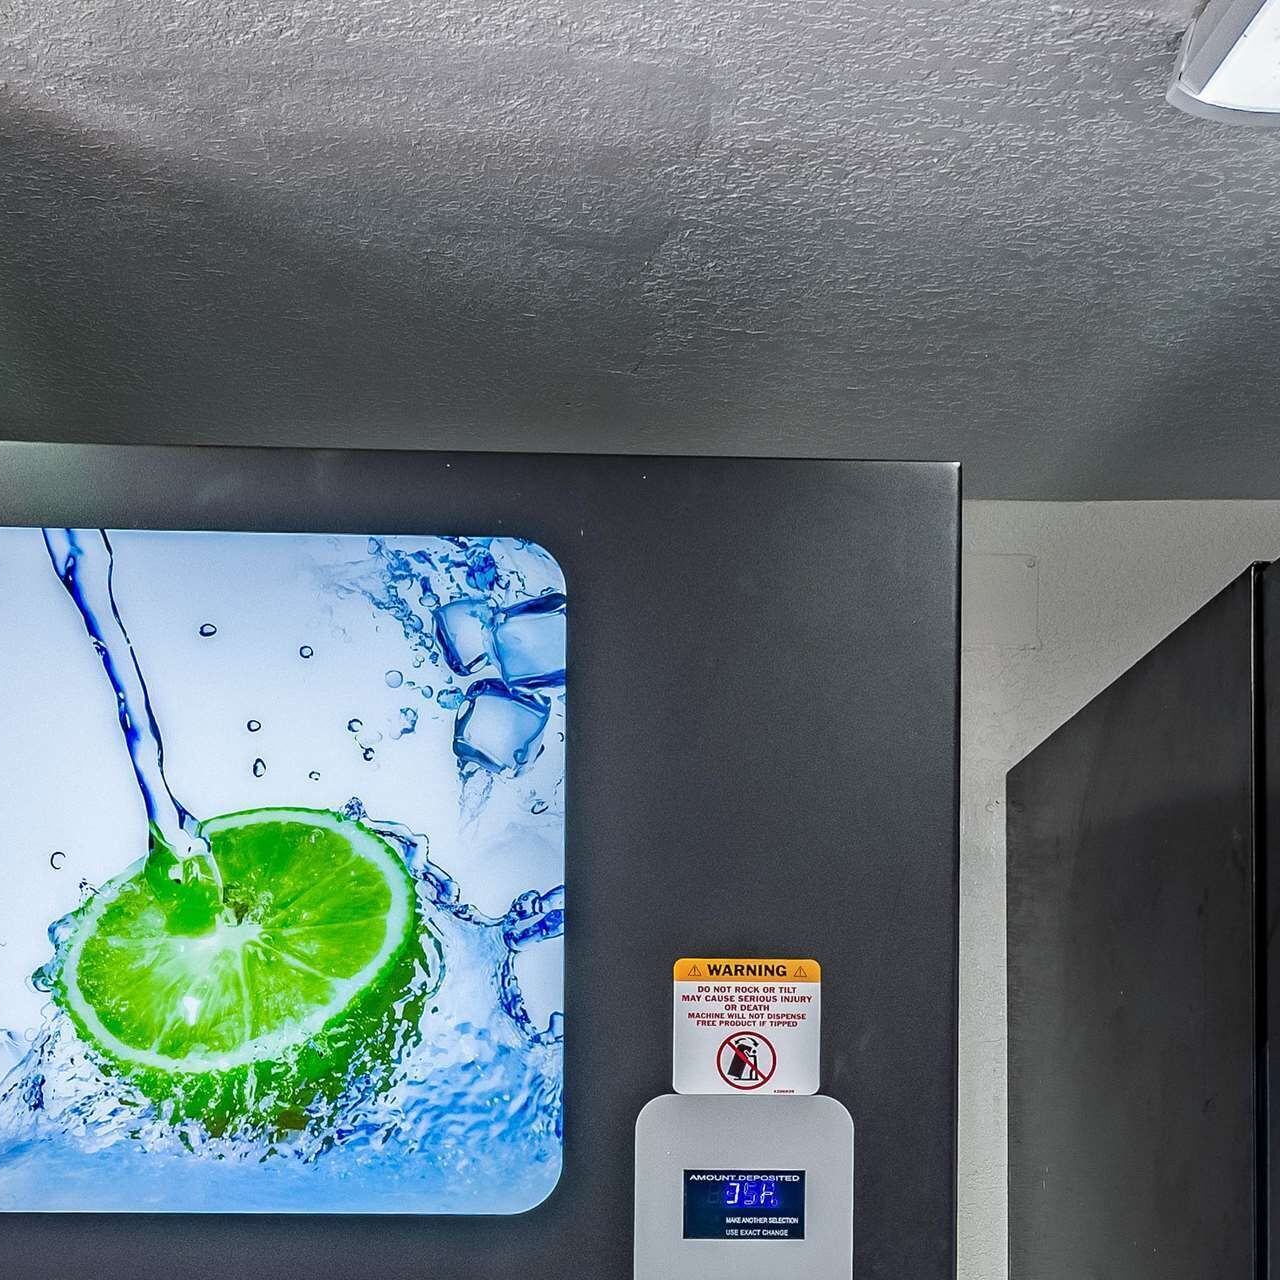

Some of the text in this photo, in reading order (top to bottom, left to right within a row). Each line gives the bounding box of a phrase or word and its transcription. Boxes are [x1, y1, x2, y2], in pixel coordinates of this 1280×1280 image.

[707, 964, 788, 977] WARNING
[762, 986, 776, 994] OR
[738, 995, 778, 1003] SERIOUS
[689, 1174, 736, 1182] AMOUNT
